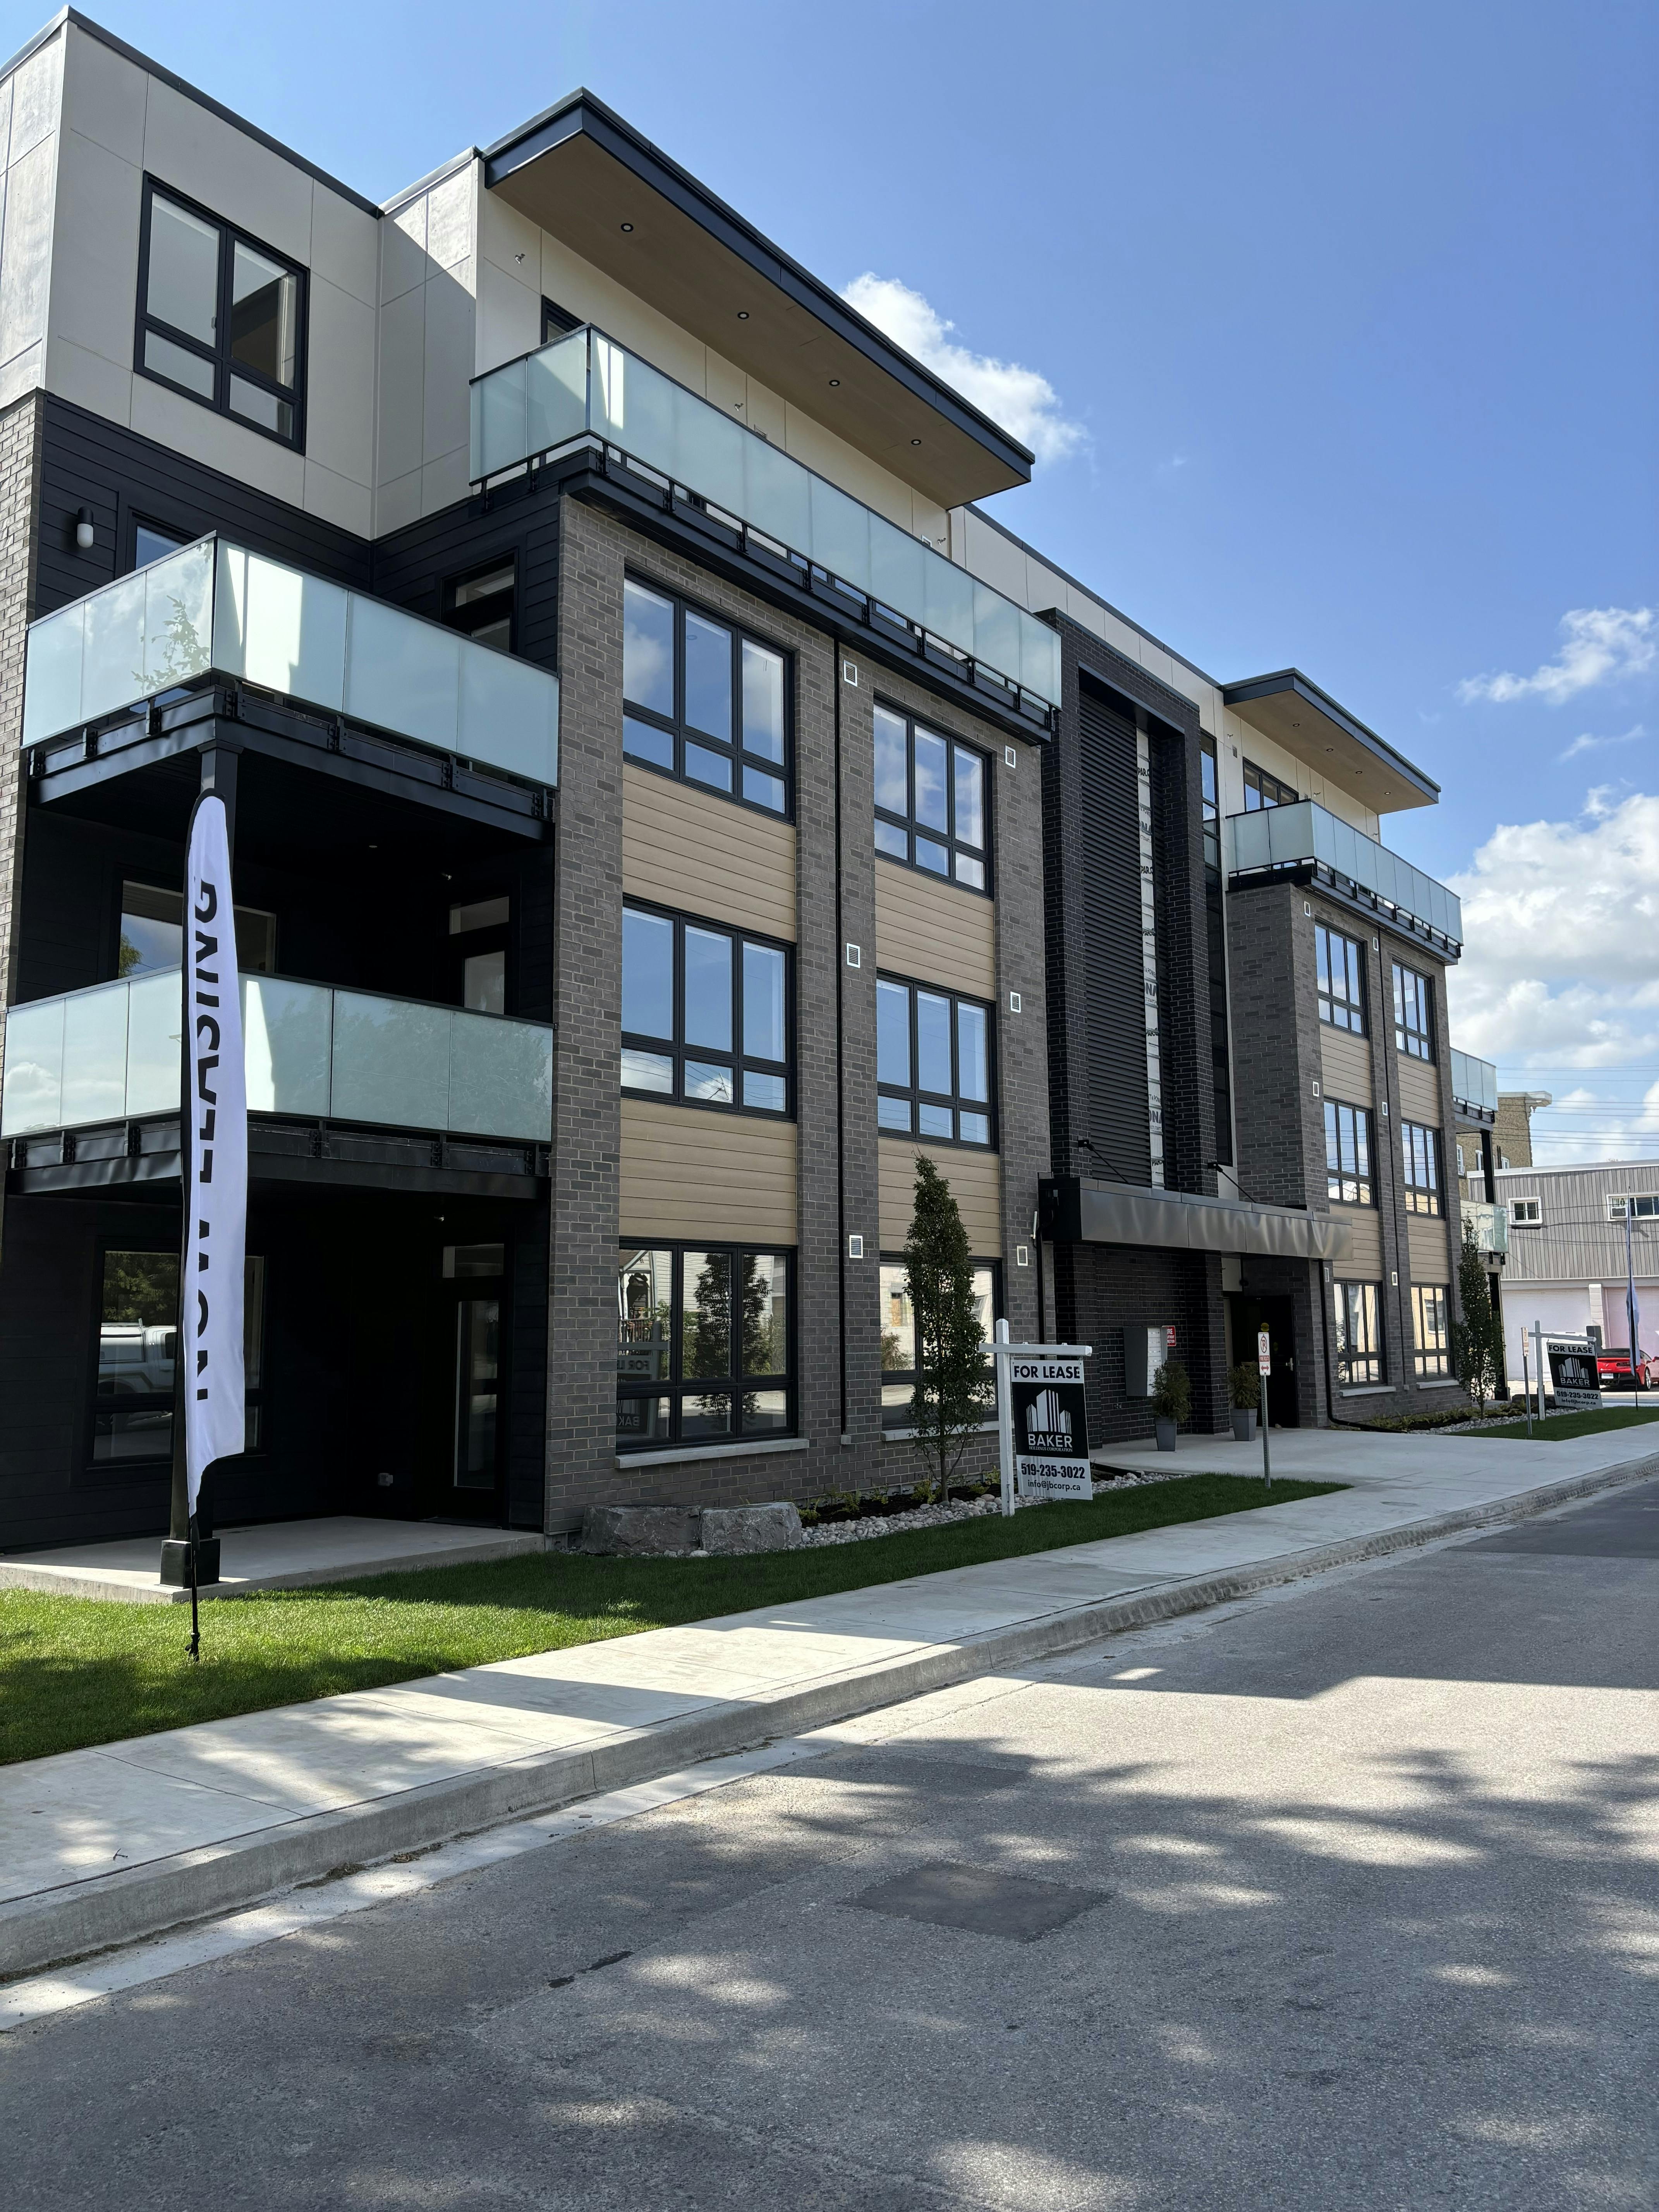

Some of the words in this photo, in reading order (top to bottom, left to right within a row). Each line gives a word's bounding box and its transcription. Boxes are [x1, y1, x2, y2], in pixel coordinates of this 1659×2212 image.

[1014, 1365, 1039, 1378] FOR
[1043, 1366, 1080, 1379] LEASE
[1560, 1377, 1590, 1386] BAKER
[1028, 1434, 1072, 1448] BAKER
[1021, 1463, 1085, 1479] 519-235-3022
[1028, 1480, 1080, 1491] info@jbcorp.ca
